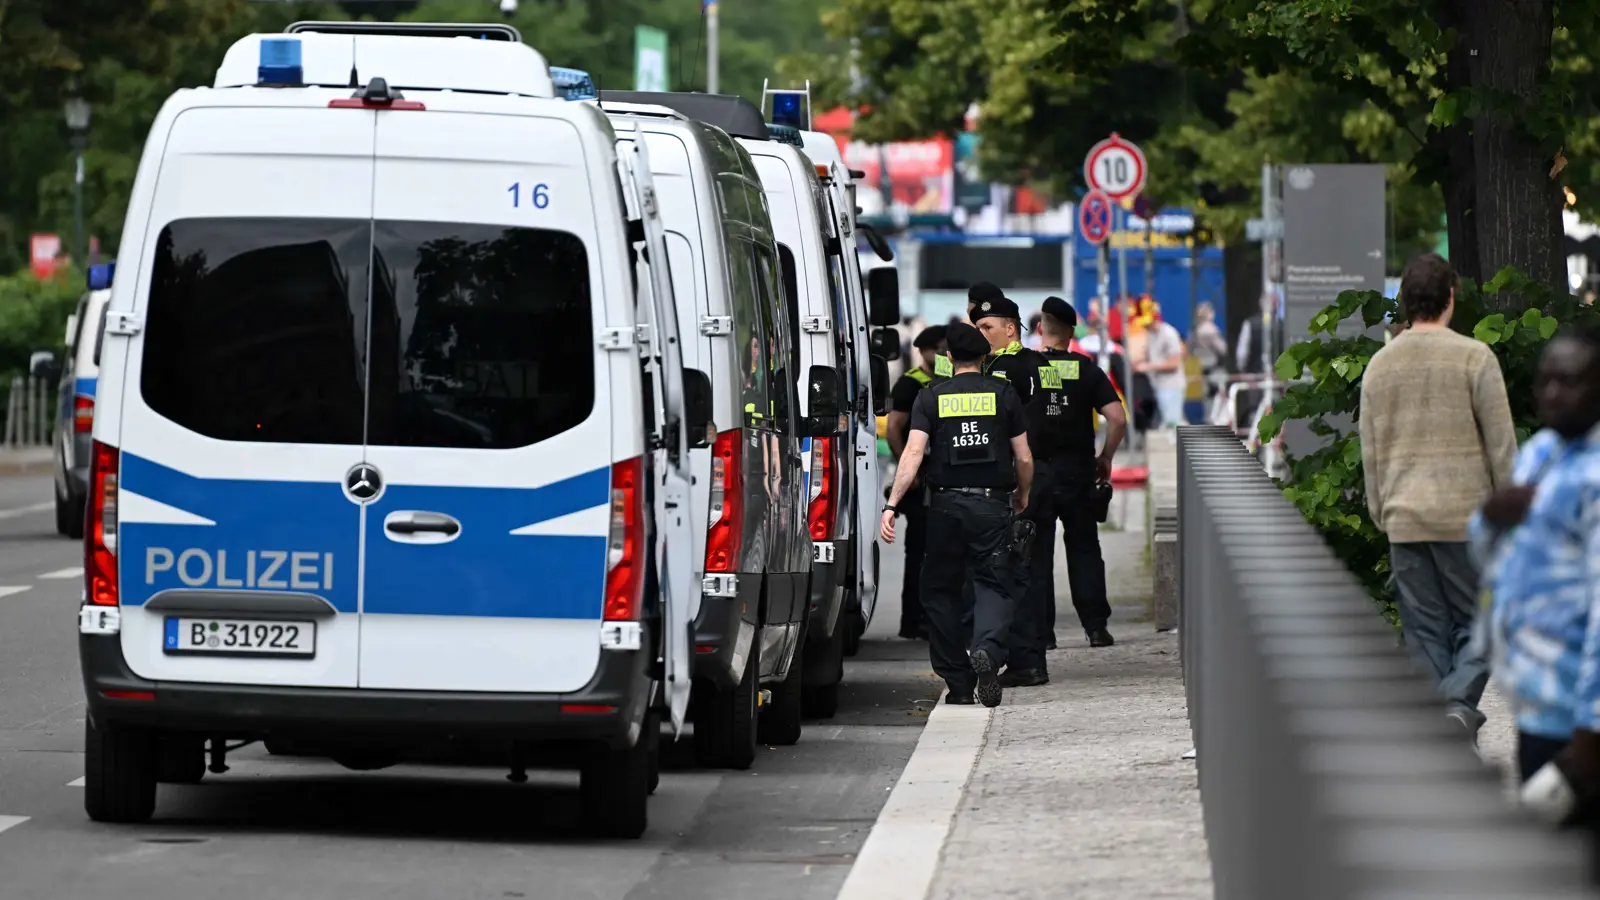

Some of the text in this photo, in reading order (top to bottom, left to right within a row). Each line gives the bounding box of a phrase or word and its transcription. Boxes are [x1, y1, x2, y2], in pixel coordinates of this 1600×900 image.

[1103, 156, 1127, 184] 10
[941, 396, 993, 413] POLIZEI
[1050, 392, 1057, 403] BE
[961, 421, 978, 433] BE
[952, 433, 989, 447] 16326
[145, 547, 333, 590] POLIZEI
[191, 623, 205, 646] B
[223, 624, 299, 648] 31922
